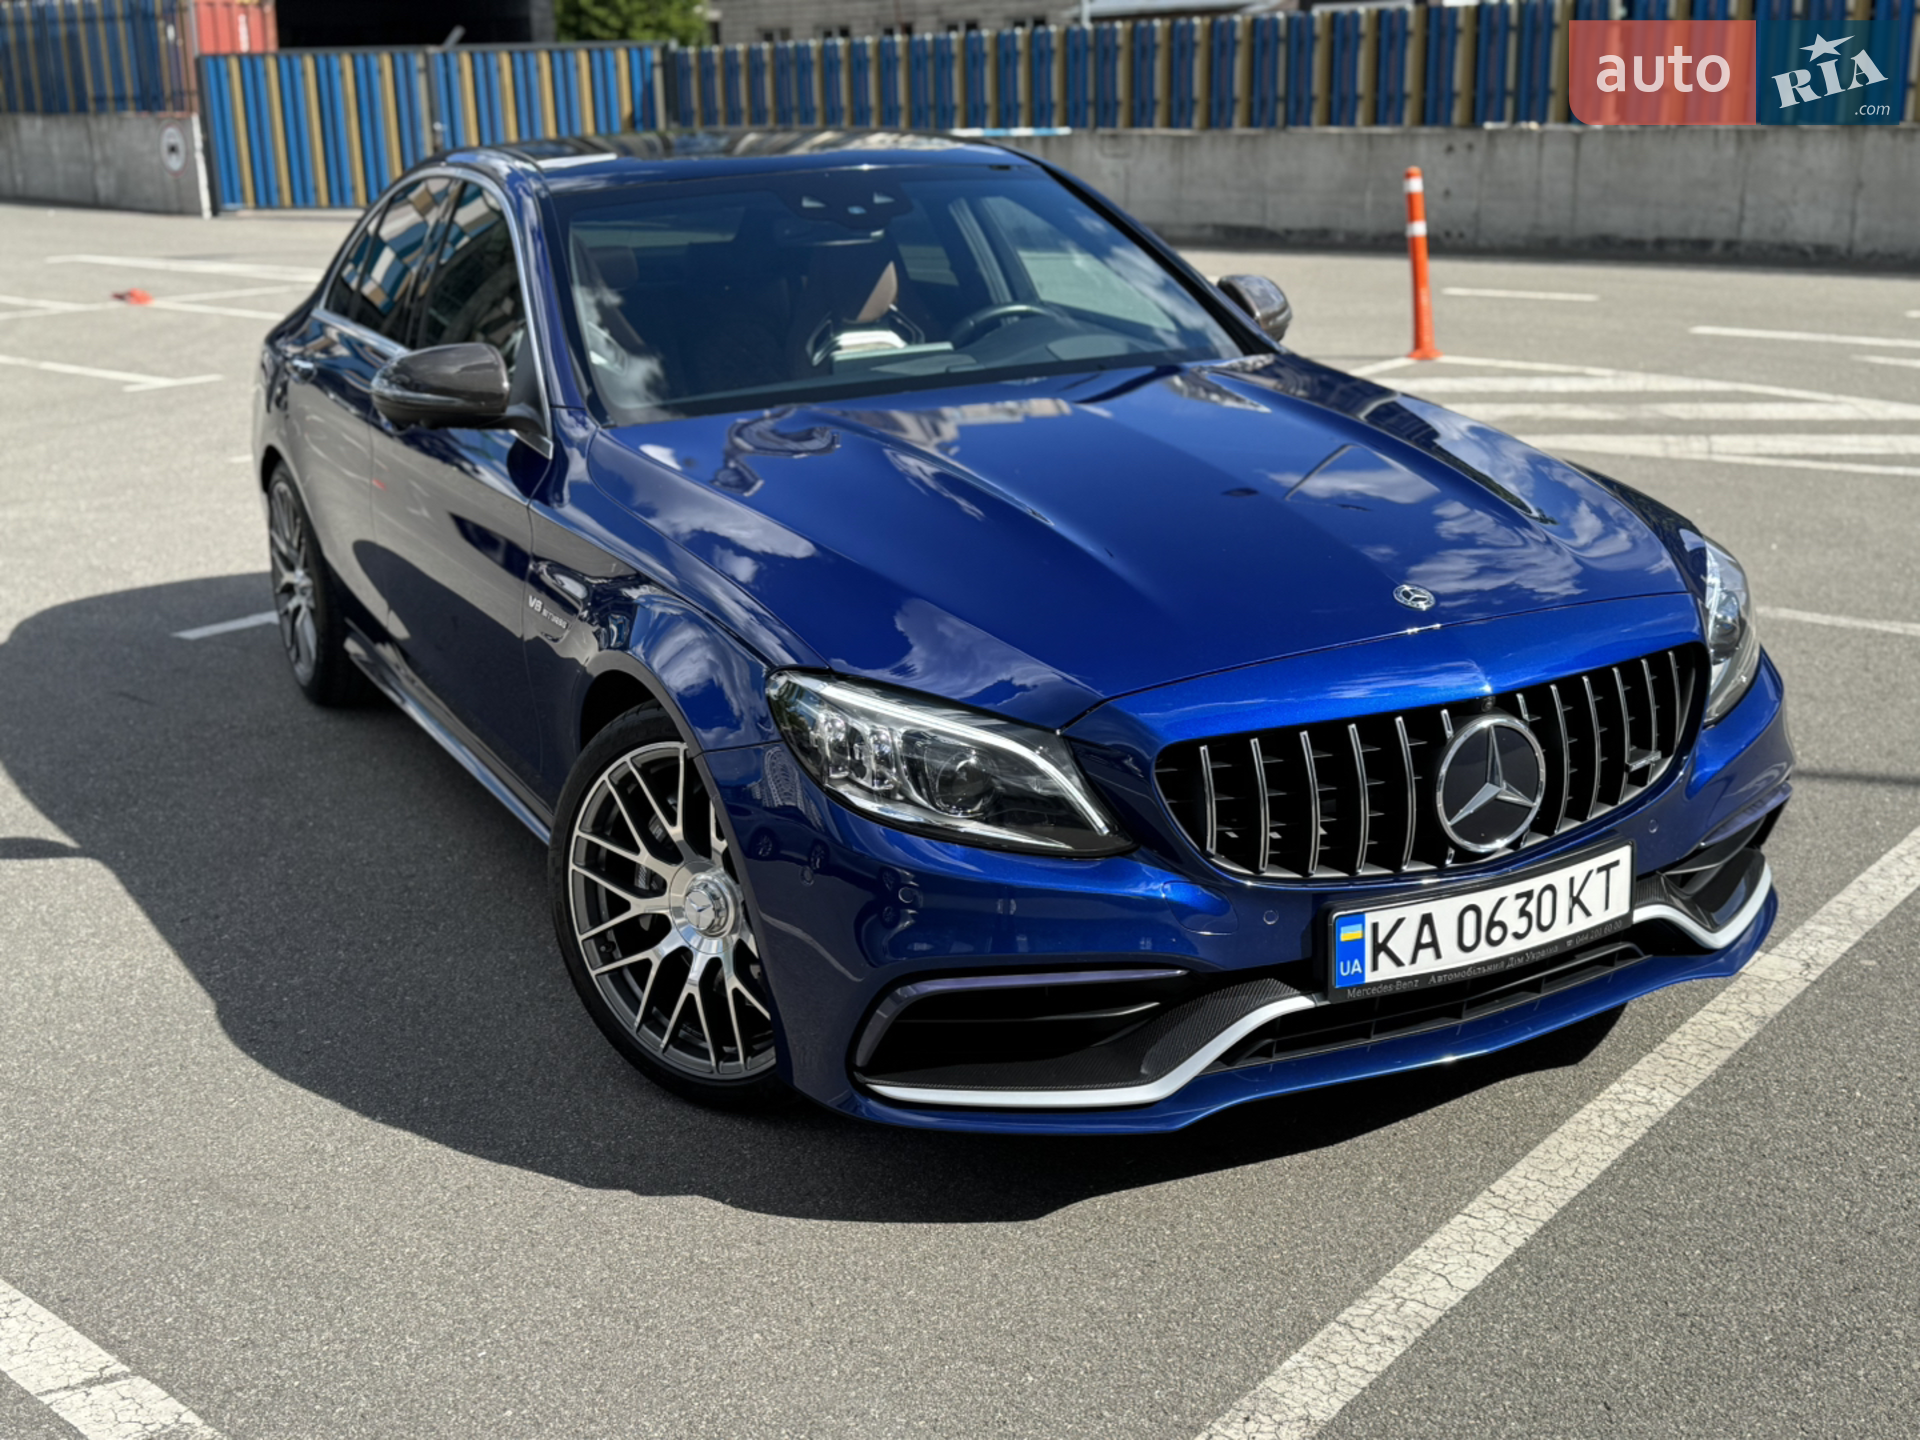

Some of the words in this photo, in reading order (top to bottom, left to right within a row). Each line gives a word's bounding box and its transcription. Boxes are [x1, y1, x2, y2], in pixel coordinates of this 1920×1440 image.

[528, 595, 543, 612] V8
[1370, 912, 1443, 973] KA
[1457, 883, 1557, 953] 0630
[1568, 859, 1621, 926] KT
[1340, 958, 1363, 976] UA
